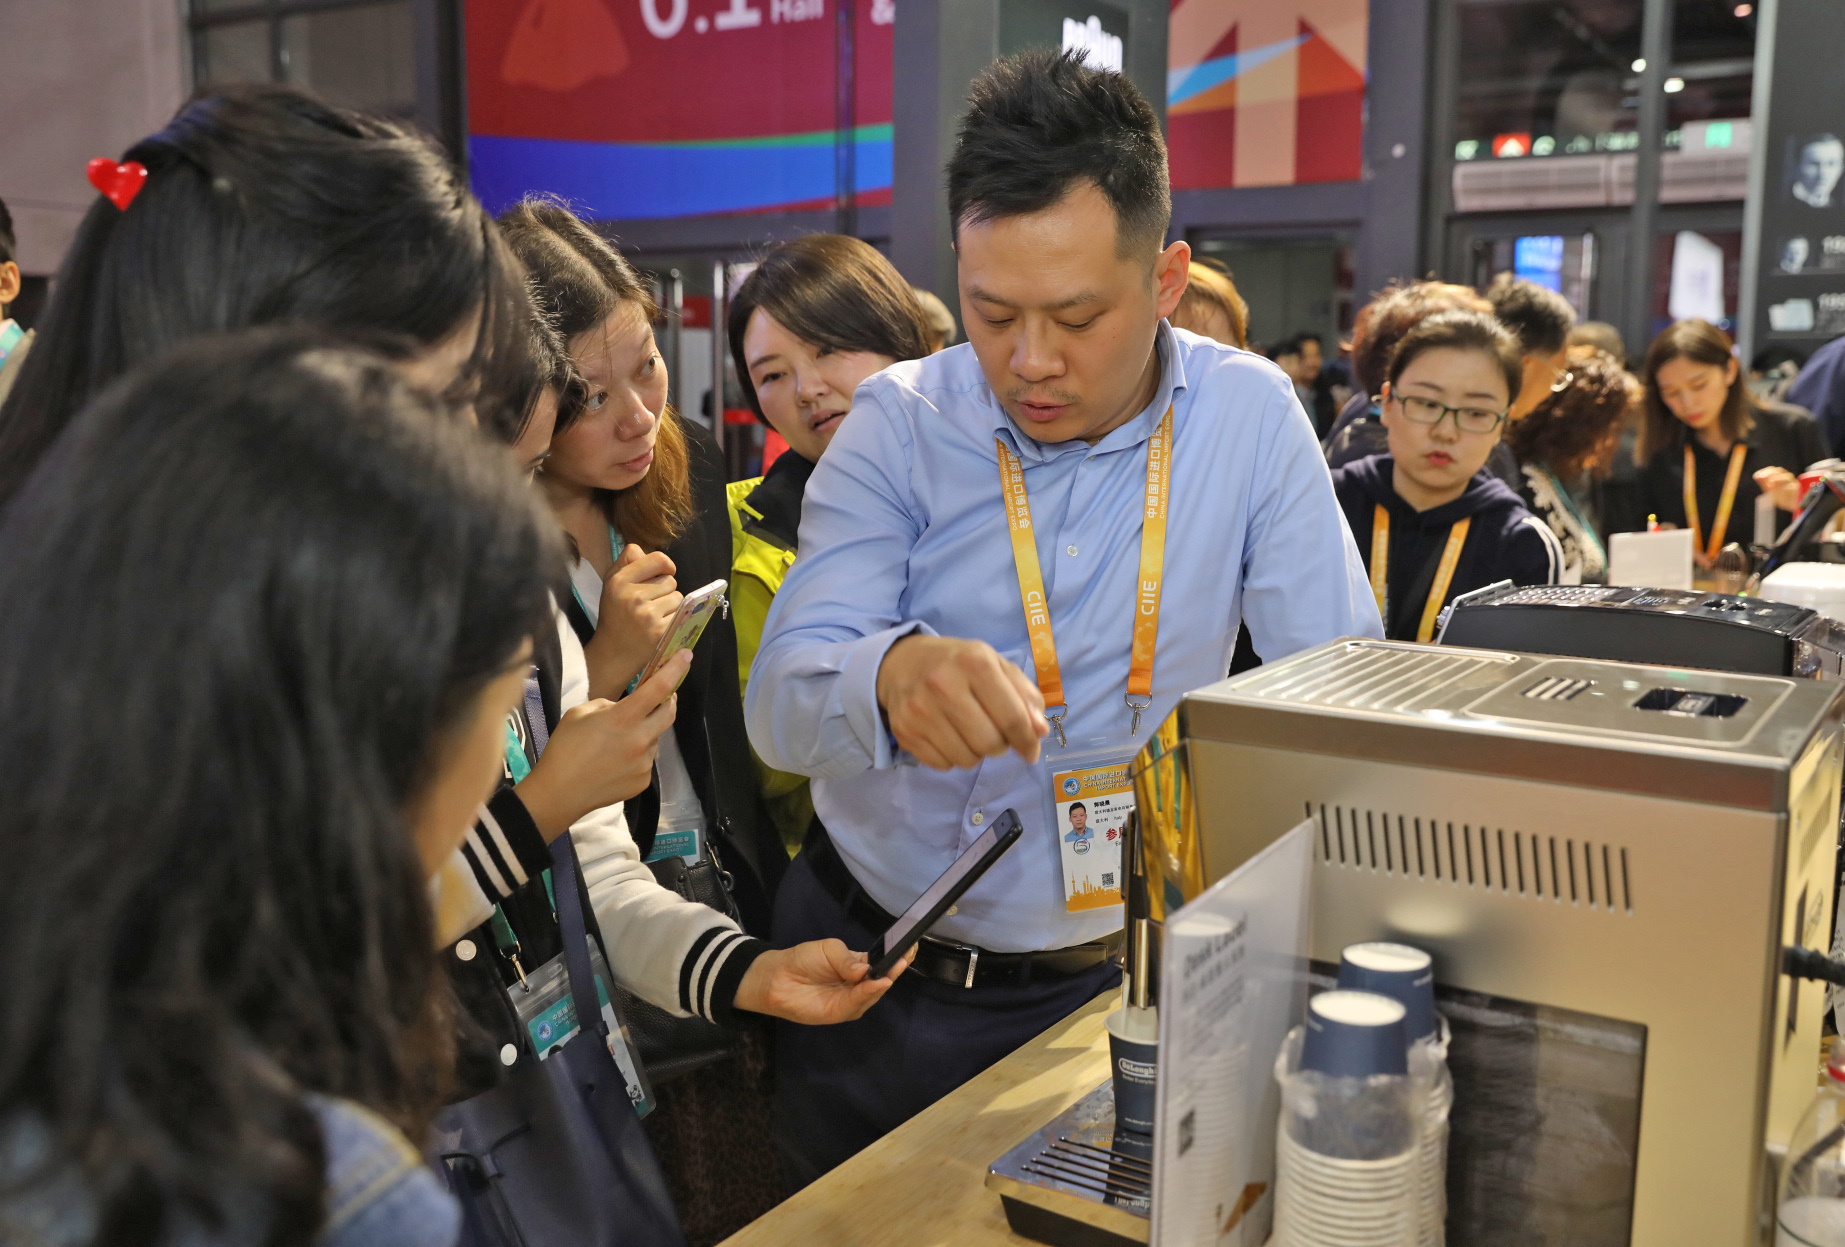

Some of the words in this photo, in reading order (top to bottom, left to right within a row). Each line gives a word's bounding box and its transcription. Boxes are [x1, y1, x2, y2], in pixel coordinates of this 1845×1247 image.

[769, 0, 824, 23] Hall
[1000, 449, 1010, 491] INTERNATIONAL
[1006, 493, 1014, 513] IMPORT
[1010, 515, 1018, 531] EXPO
[1006, 446, 1030, 529] 国际进口博览会
[1161, 453, 1169, 499] INTERNATIONAL
[1027, 591, 1046, 626] CIIE
[1141, 580, 1157, 615] CIIE
